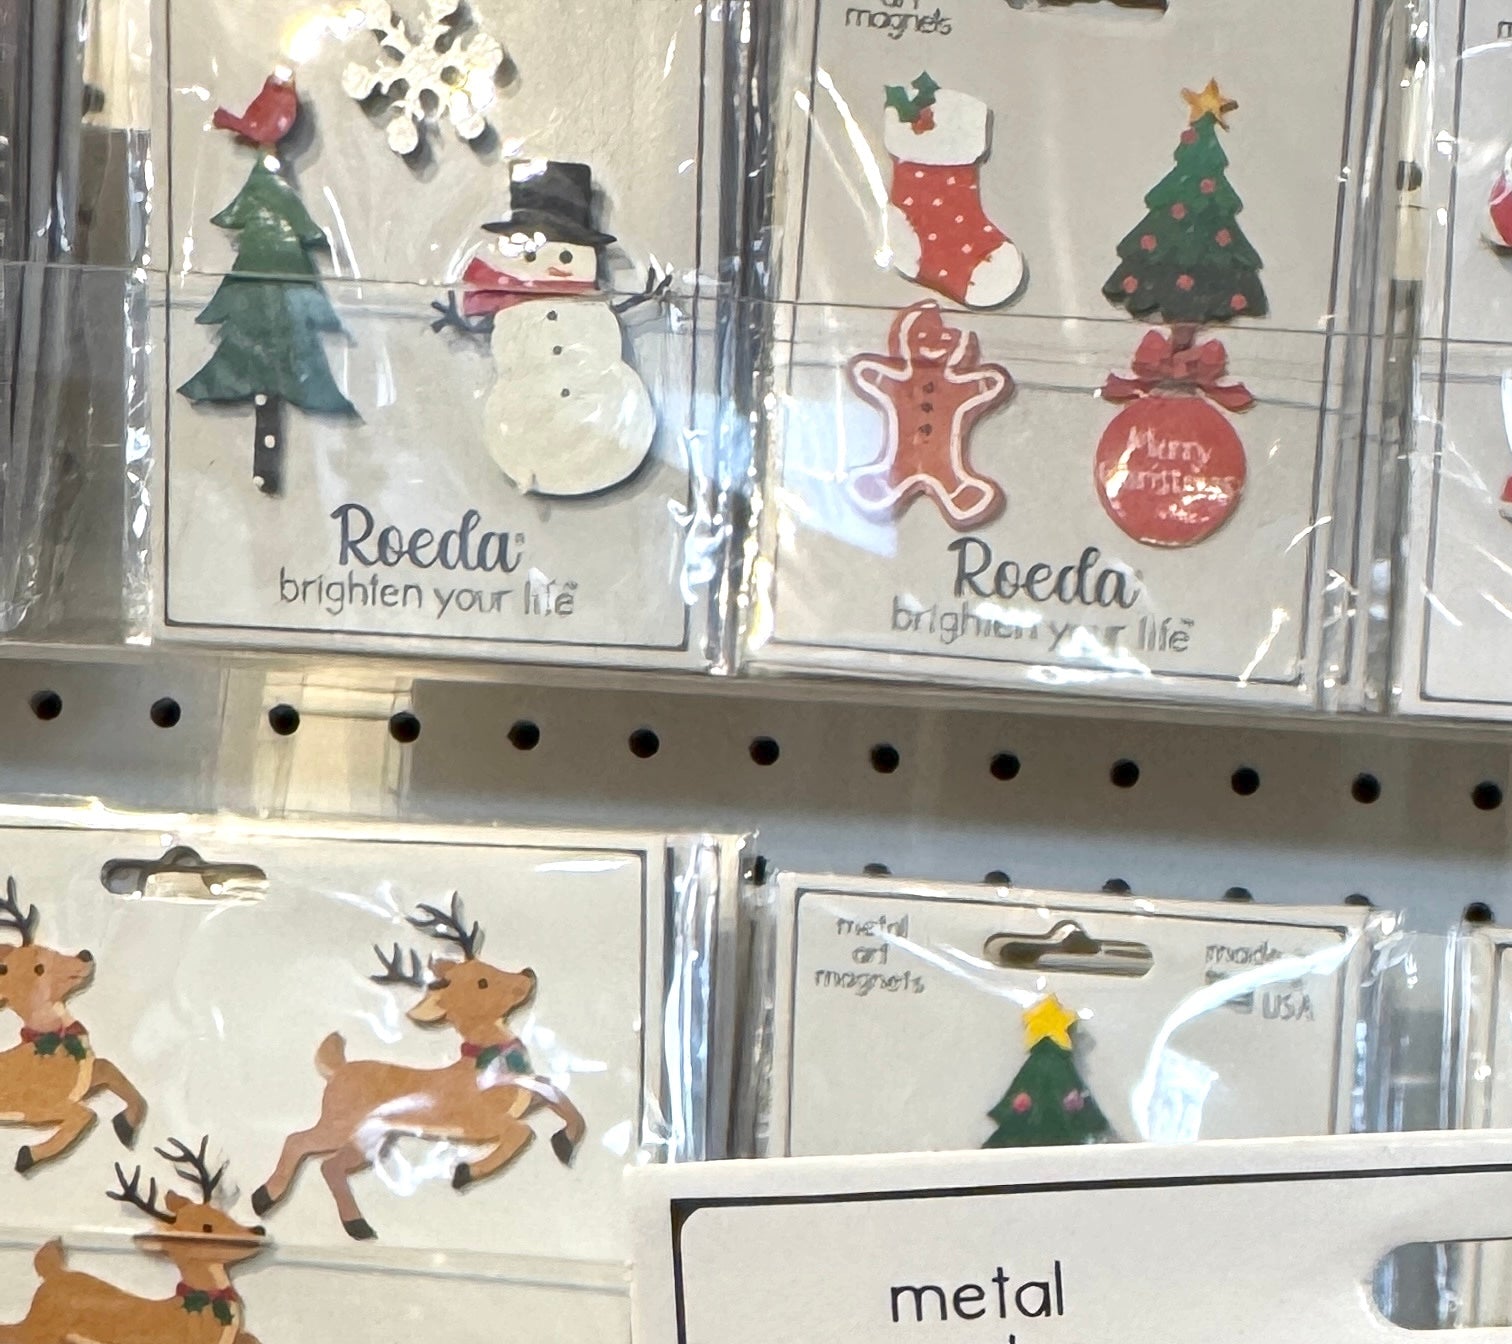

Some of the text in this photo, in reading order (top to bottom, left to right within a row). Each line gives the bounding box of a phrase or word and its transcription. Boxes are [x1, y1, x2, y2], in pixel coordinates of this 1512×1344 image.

[280, 566, 423, 616] brighten
[433, 587, 513, 619] your
[890, 1260, 1064, 1322] metal
